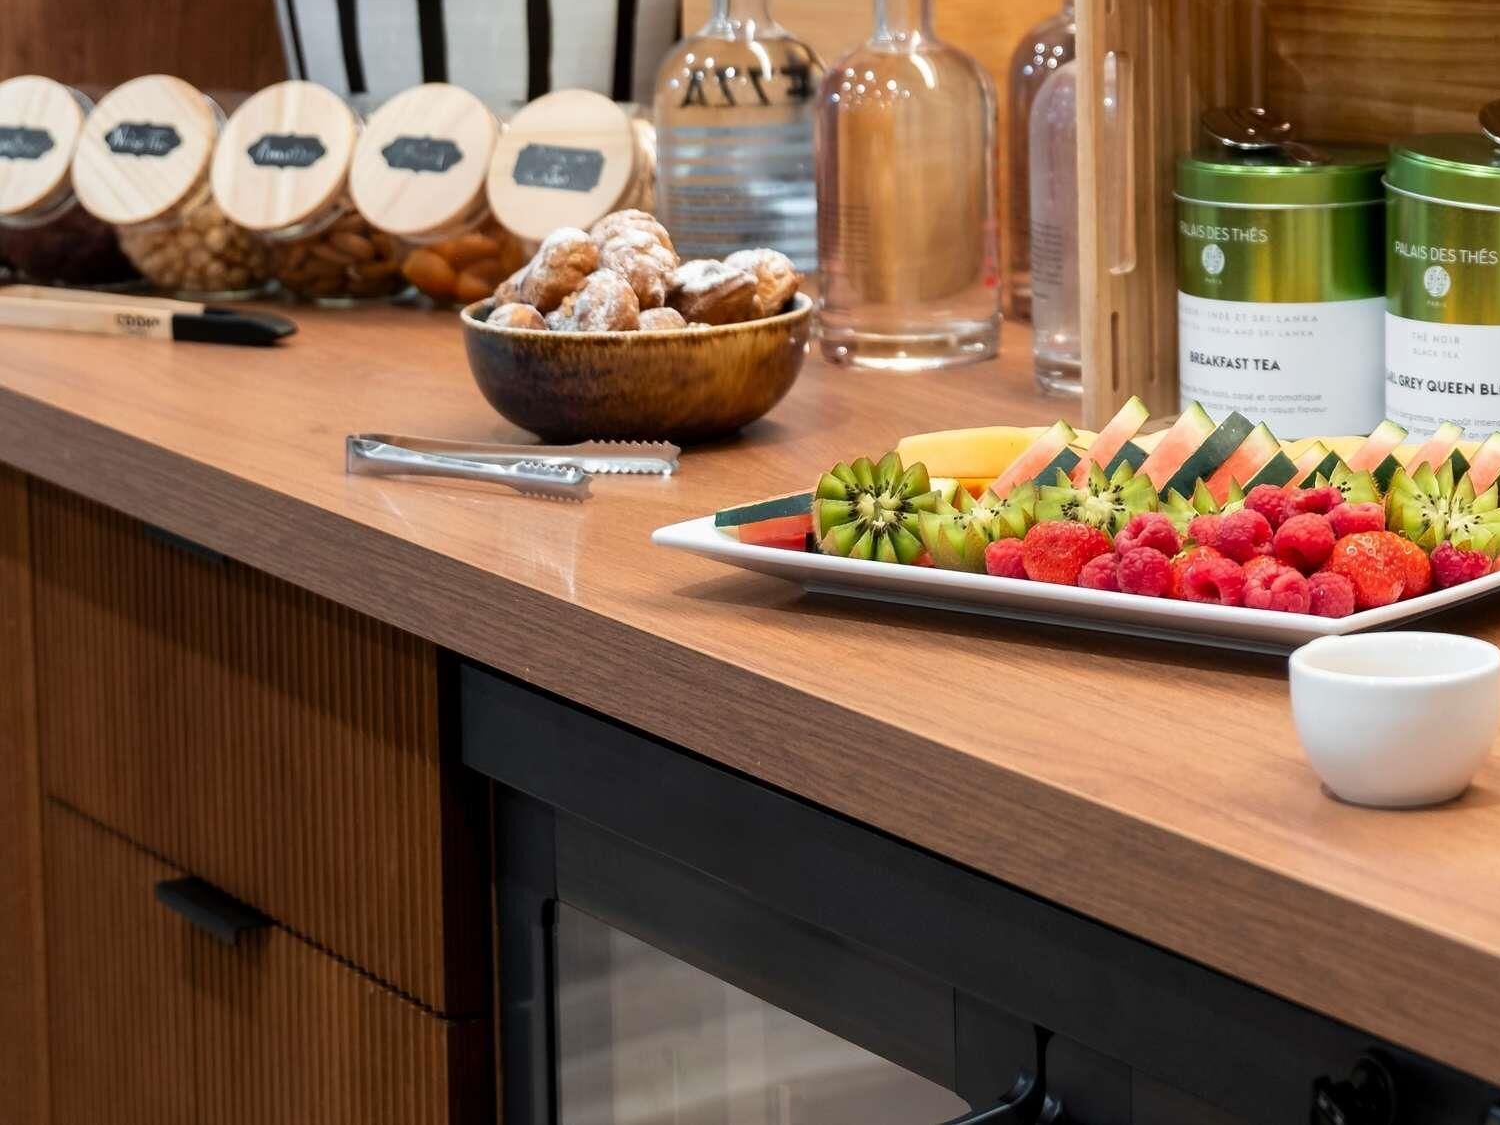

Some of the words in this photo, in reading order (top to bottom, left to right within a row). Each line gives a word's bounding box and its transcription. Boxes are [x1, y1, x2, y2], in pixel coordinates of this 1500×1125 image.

[1207, 226, 1230, 241] DES
[1395, 241, 1428, 260] PALAIS
[1430, 247, 1457, 262] DES
[1460, 248, 1499, 265] THÉS
[1276, 314, 1319, 324] LANKA
[1432, 335, 1460, 344] NOIR
[1189, 350, 1249, 371] BREAKFAST
[1253, 358, 1281, 371] TEA
[1399, 375, 1424, 390] GREY
[1427, 379, 1475, 395] QUEEN
